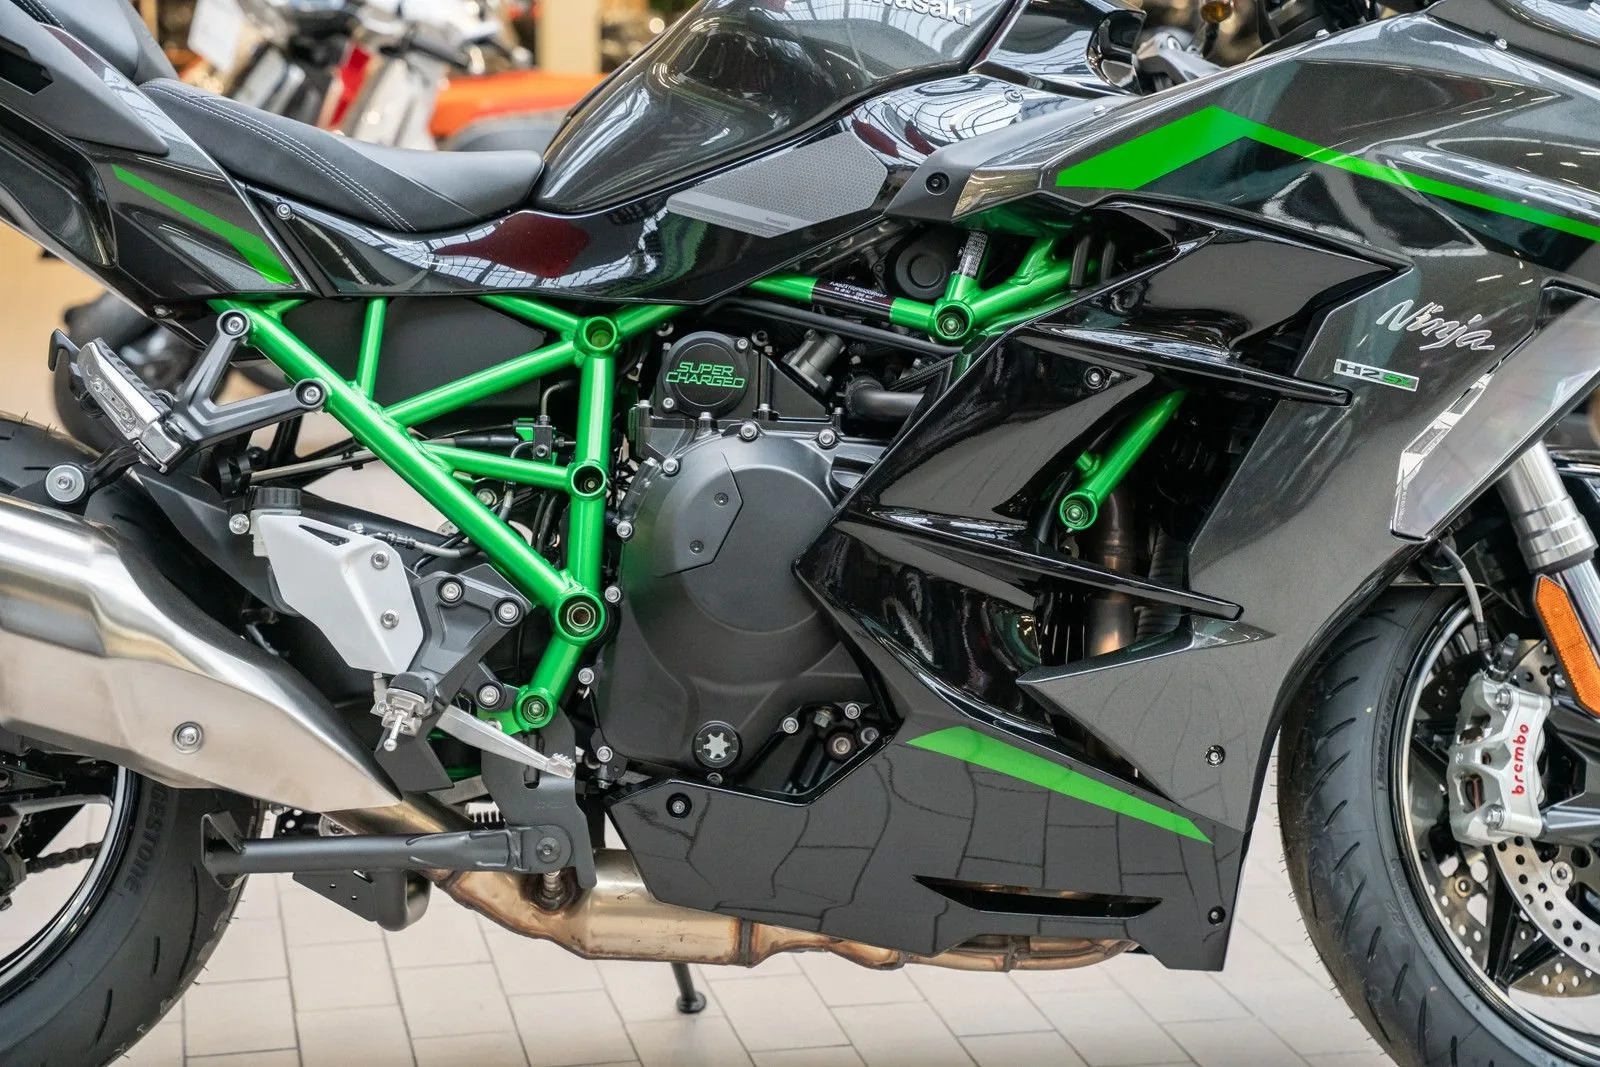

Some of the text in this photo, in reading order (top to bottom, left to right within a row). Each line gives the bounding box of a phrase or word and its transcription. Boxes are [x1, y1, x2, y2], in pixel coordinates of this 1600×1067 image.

[1375, 299, 1496, 351] Ninja
[665, 372, 746, 388] CHARGED
[677, 361, 735, 376] SUPER
[1511, 724, 1529, 795] brembo
